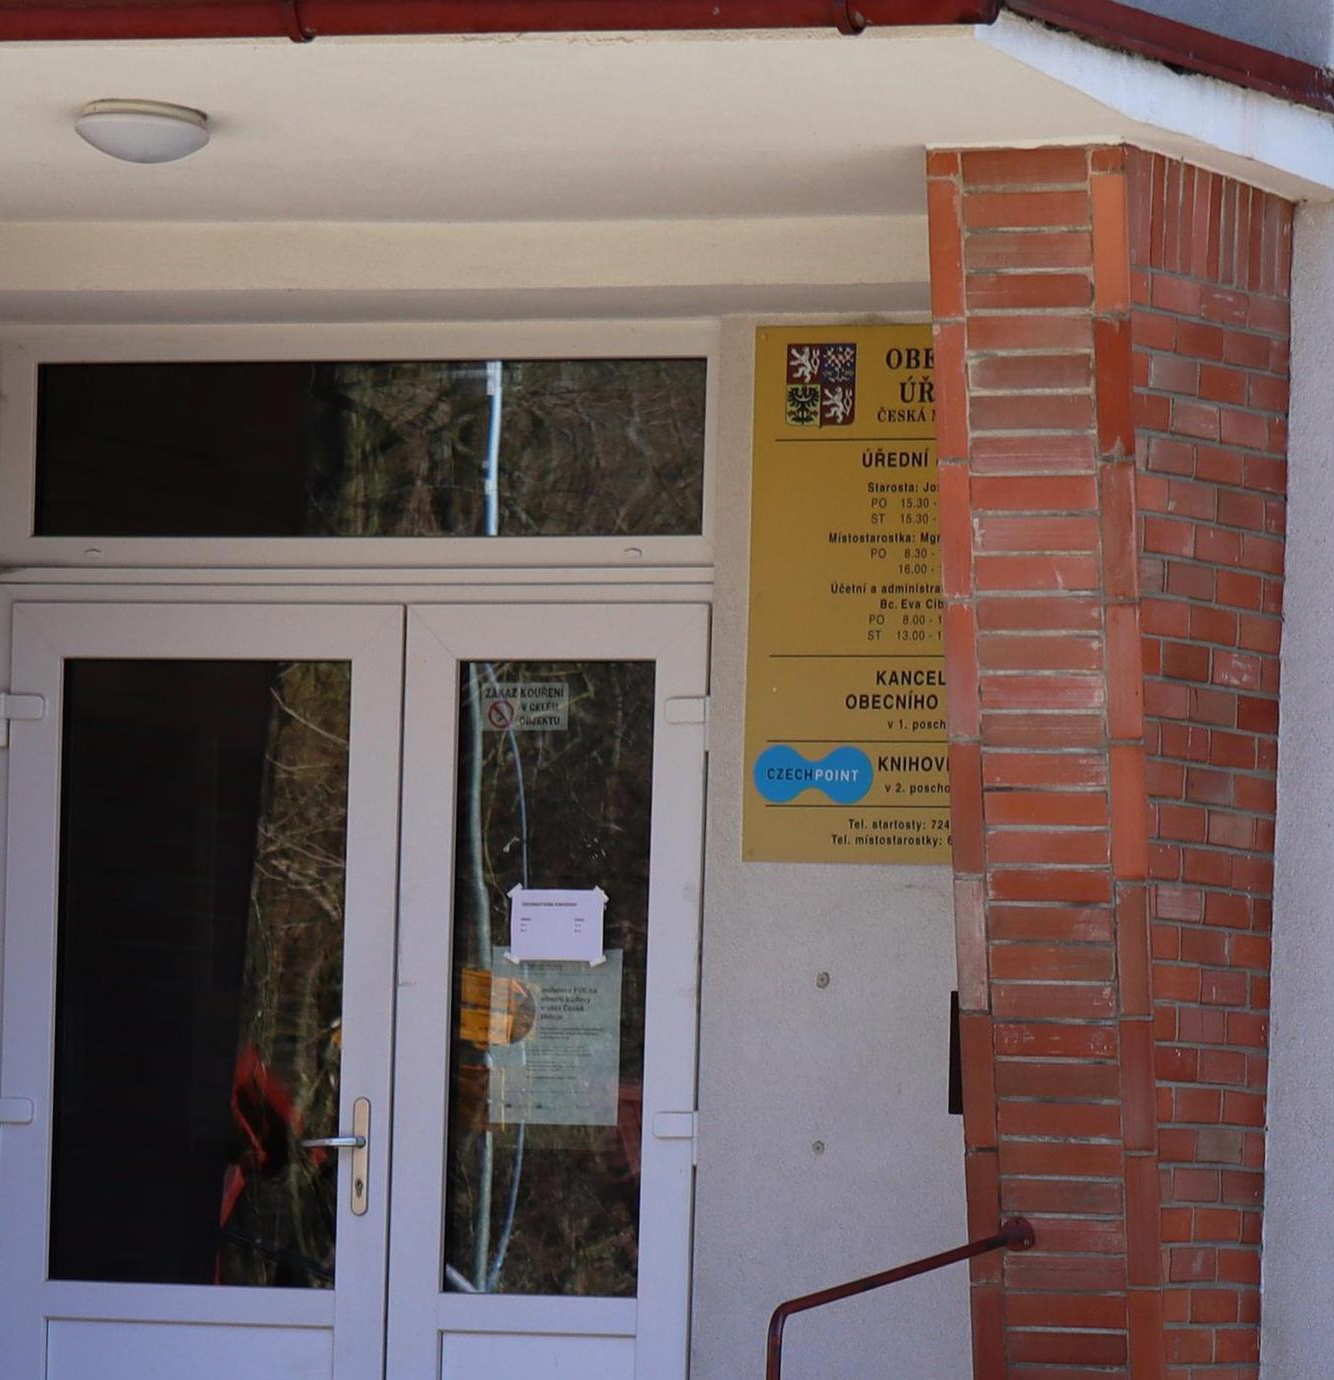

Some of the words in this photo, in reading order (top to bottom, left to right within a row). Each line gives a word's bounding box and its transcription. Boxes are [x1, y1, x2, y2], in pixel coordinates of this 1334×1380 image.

[877, 407, 927, 422] ČESKÁ
[862, 448, 929, 467] ÚŘEDNÍ
[868, 482, 919, 493] Starosta:
[871, 498, 887, 509] PO
[901, 498, 929, 509] 15.30
[871, 513, 885, 524] ST
[900, 513, 929, 524] 15.30
[870, 548, 887, 559] PO
[899, 563, 927, 574] 16.00
[831, 581, 866, 593] Účetní
[880, 599, 898, 609] Bc.
[901, 599, 921, 609] Eva
[869, 615, 885, 625] PO
[902, 615, 925, 625] 8.00
[867, 631, 881, 641] ST
[897, 630, 925, 641] 13.00
[876, 670, 947, 686] KANCEL
[845, 690, 939, 710] OBECNÍHO
[887, 721, 894, 729] v
[899, 719, 908, 729] 1.
[912, 719, 946, 732] posch
[767, 768, 859, 782] CZECHPOINT
[885, 784, 891, 793] v
[895, 783, 905, 793] 2.
[848, 819, 868, 830] Tel.
[832, 834, 851, 845] Tel.
